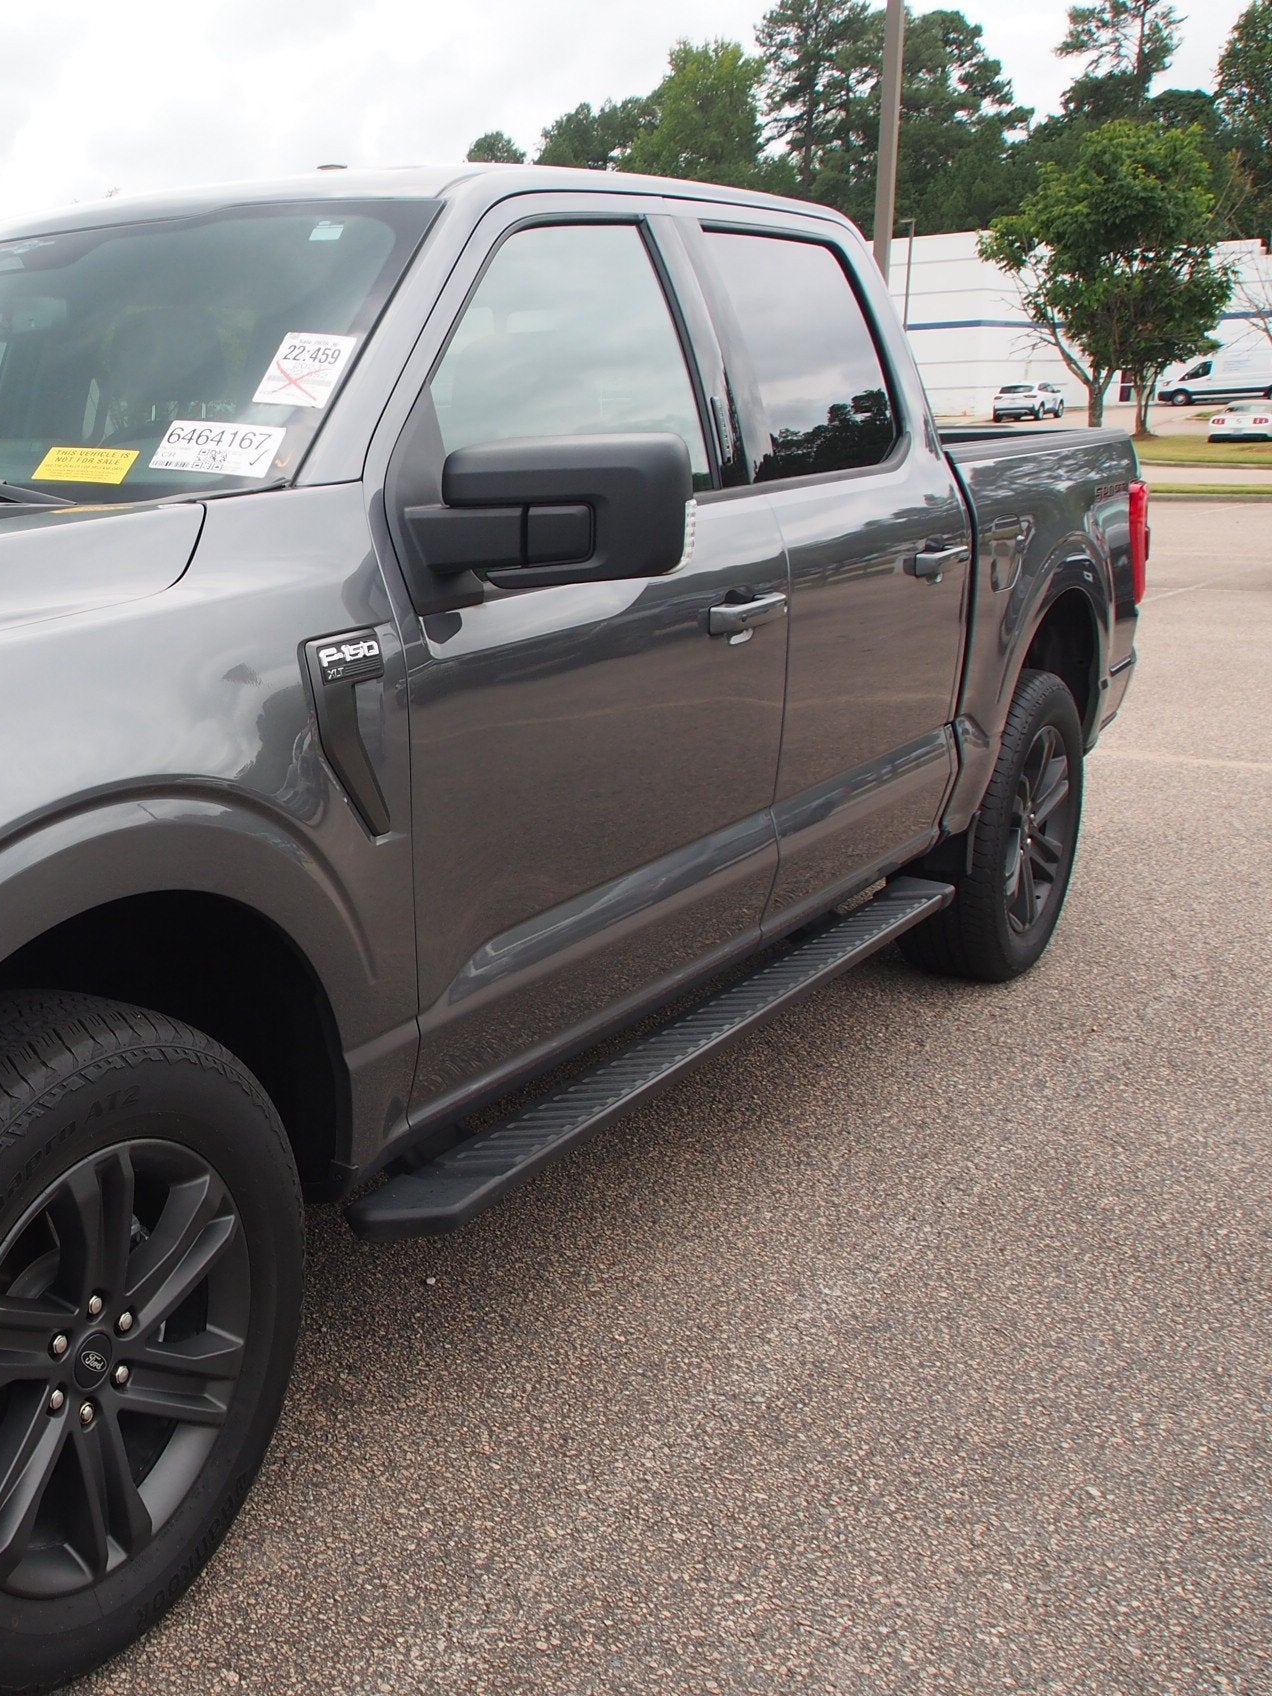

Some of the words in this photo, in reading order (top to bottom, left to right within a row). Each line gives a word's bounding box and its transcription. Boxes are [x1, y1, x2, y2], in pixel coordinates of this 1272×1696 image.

[283, 344, 341, 365] 22:459
[167, 426, 273, 450] 6464167
[79, 450, 119, 458] VEHICLE
[319, 641, 380, 667] F-150
[327, 666, 344, 680] XLT
[84, 1352, 105, 1371] Ford
